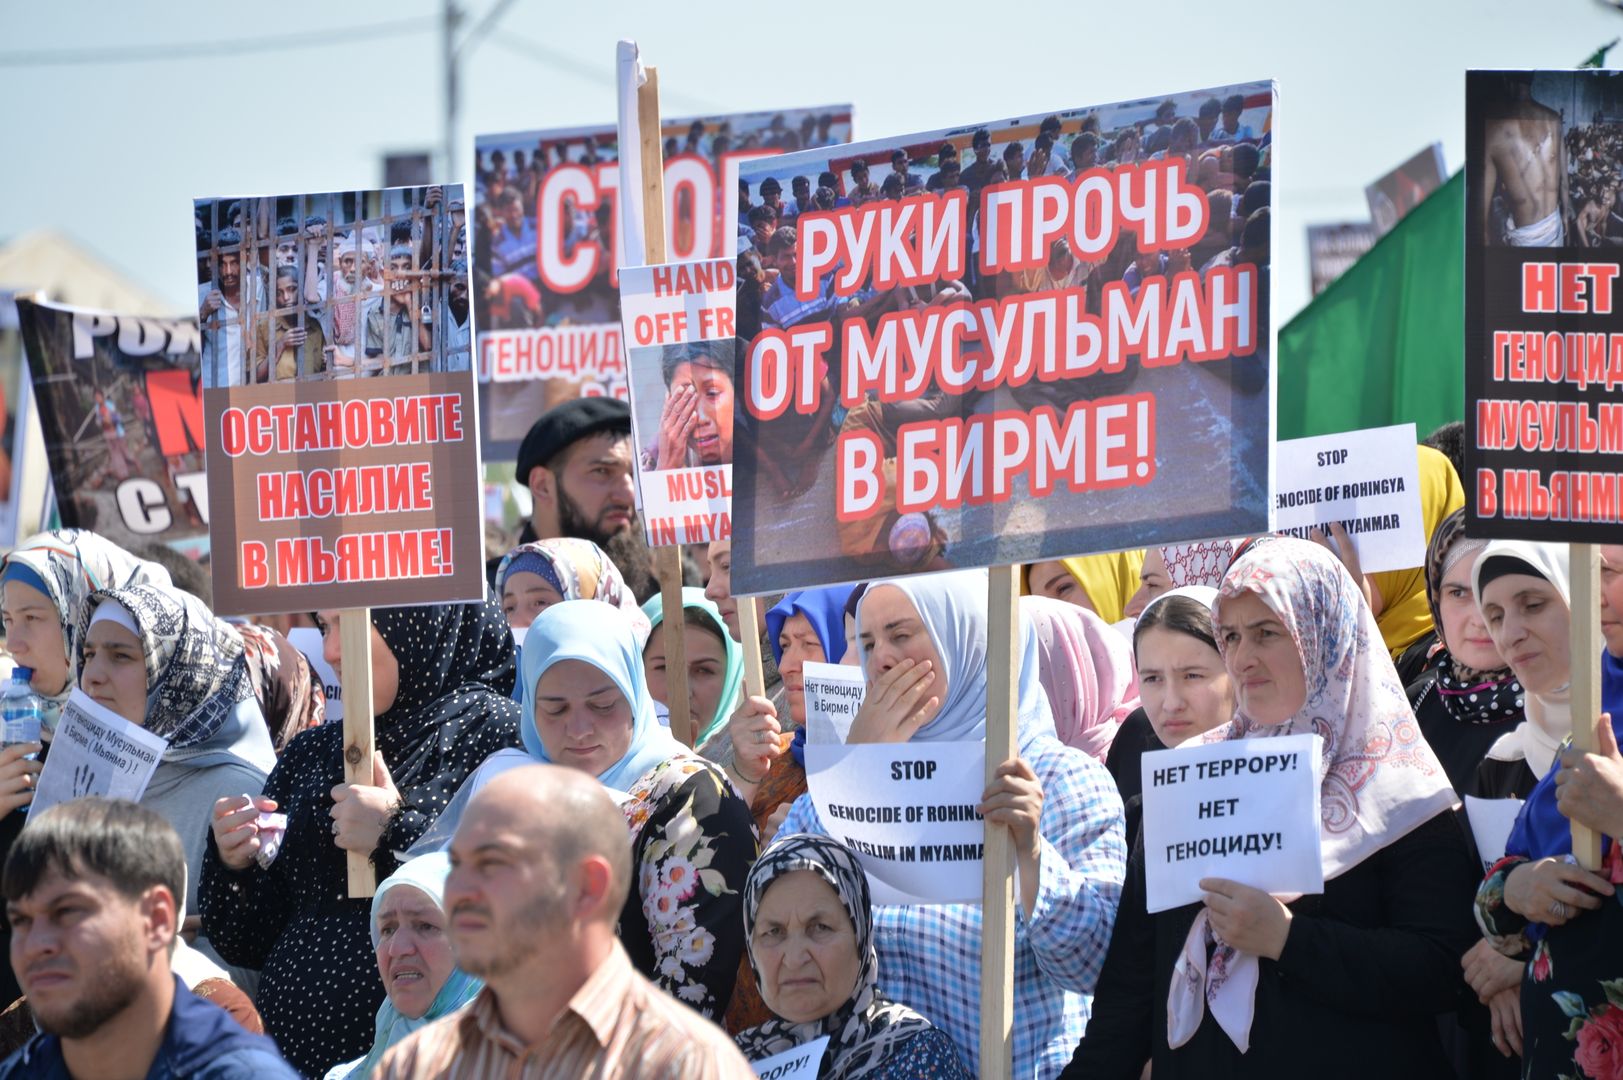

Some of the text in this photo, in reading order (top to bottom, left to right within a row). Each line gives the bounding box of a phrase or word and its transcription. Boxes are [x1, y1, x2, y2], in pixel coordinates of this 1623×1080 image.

[801, 165, 1202, 293] РУКИ ПРОЧЬ
[653, 261, 734, 297] HAND
[1522, 262, 1620, 314] НЕТ
[634, 306, 735, 346] OFF FR
[751, 272, 1250, 411] ОТ МУСУЛЬМАН
[221, 394, 463, 457] ОСТАНОВИТЕ
[1477, 400, 1623, 454] МУСУЛЬМ
[843, 401, 1151, 514] В БИРМЕ!
[1317, 449, 1348, 467] STOP
[257, 462, 433, 521] НАСИЛИЕ
[666, 469, 732, 503] MUSL
[1325, 486, 1340, 502] OF
[1343, 477, 1405, 500] ROHINGYA
[1477, 468, 1498, 518] В
[650, 516, 676, 546] IN
[241, 528, 454, 589] В МЬЯНМЕ!
[815, 701, 819, 711] в
[821, 699, 849, 716] Бирме
[821, 684, 863, 700] геноциду
[105, 730, 157, 765] Мусульман
[891, 760, 937, 780] STOP
[1153, 753, 1298, 787] НЕТ ТЕРРОРУ!
[829, 804, 901, 823] GENOCIDE
[906, 806, 924, 823] OF
[1199, 798, 1239, 820] НЕТ
[845, 836, 895, 861] MYSLIM
[900, 846, 915, 862] IN
[1166, 832, 1282, 863] ГЕНОЦИДУ!
